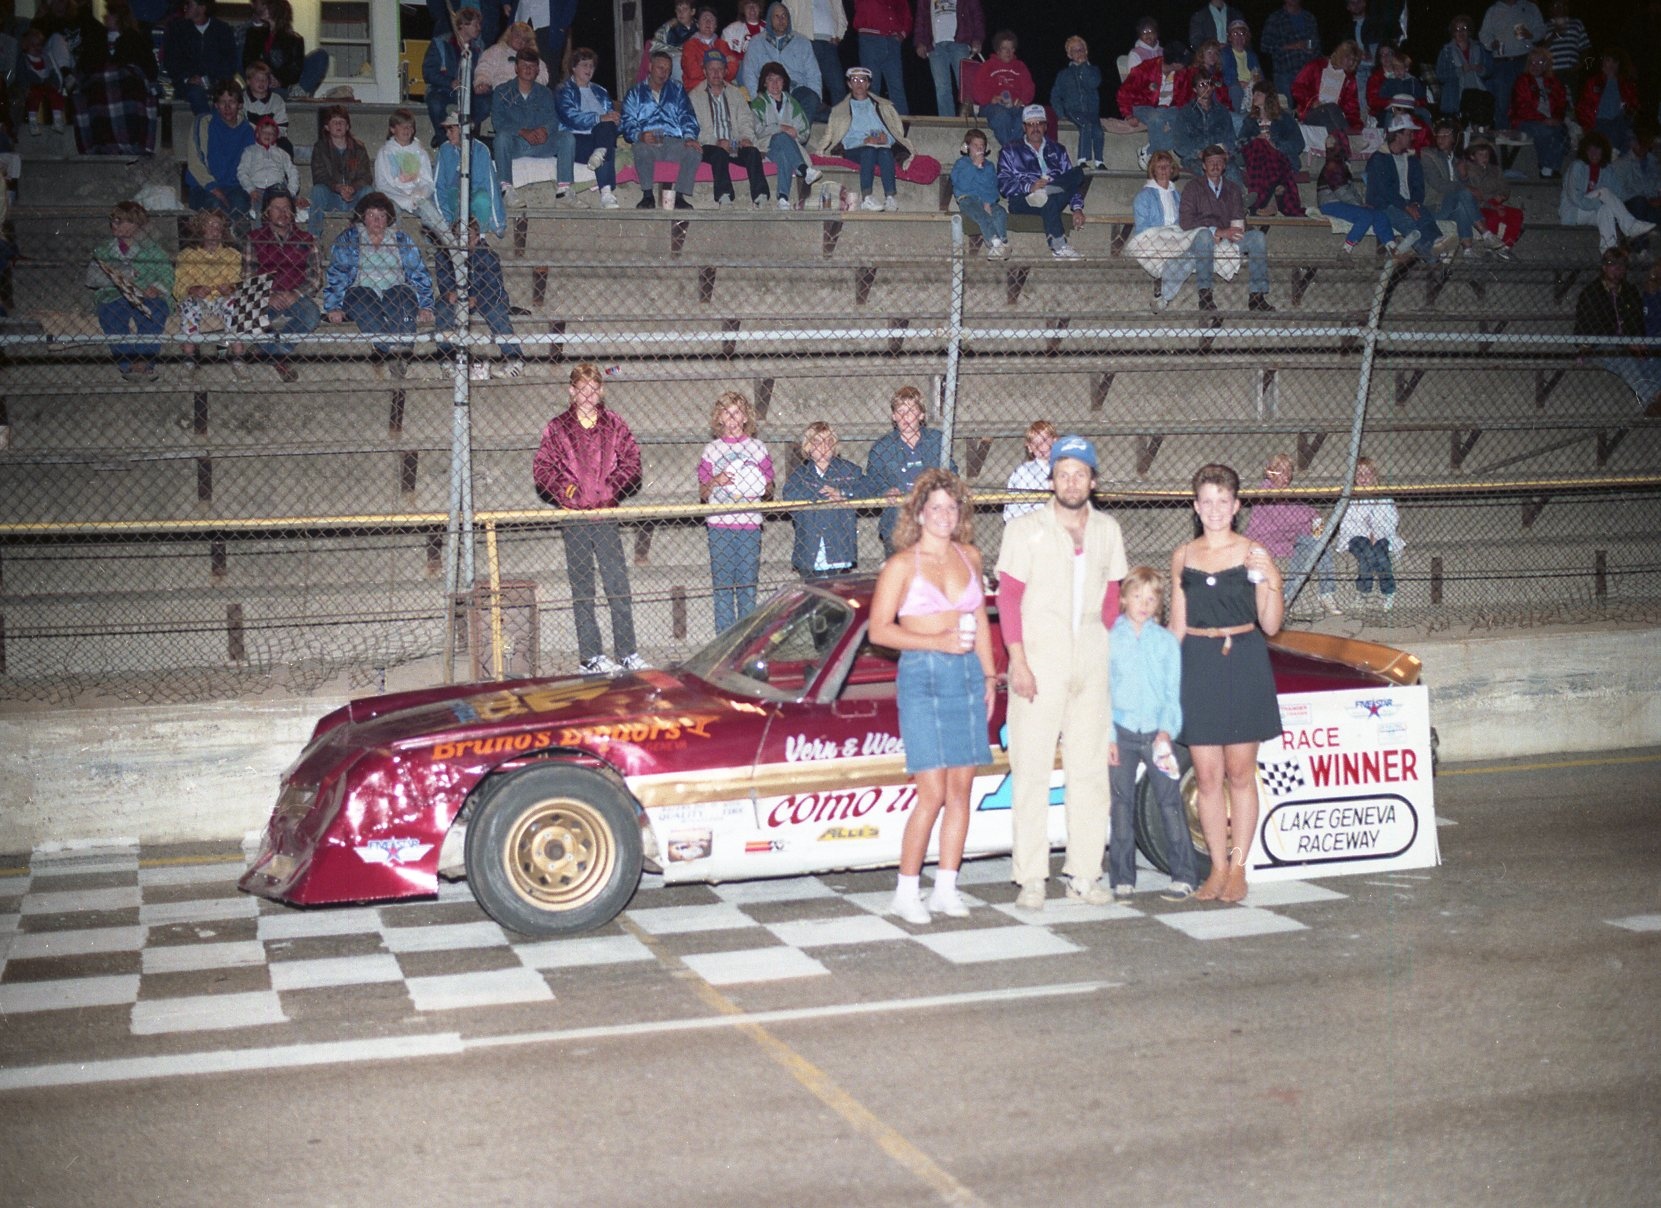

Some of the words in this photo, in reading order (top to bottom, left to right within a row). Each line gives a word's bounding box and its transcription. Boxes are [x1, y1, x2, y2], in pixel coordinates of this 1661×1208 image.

[431, 730, 552, 760] Bruno's
[842, 738, 858, 757] &
[1282, 727, 1340, 750] RACE
[1309, 749, 1419, 787] WINNER
[1280, 810, 1326, 832] LAKE
[1329, 805, 1397, 829] GENEVA
[1297, 830, 1380, 853] RACEWAY
